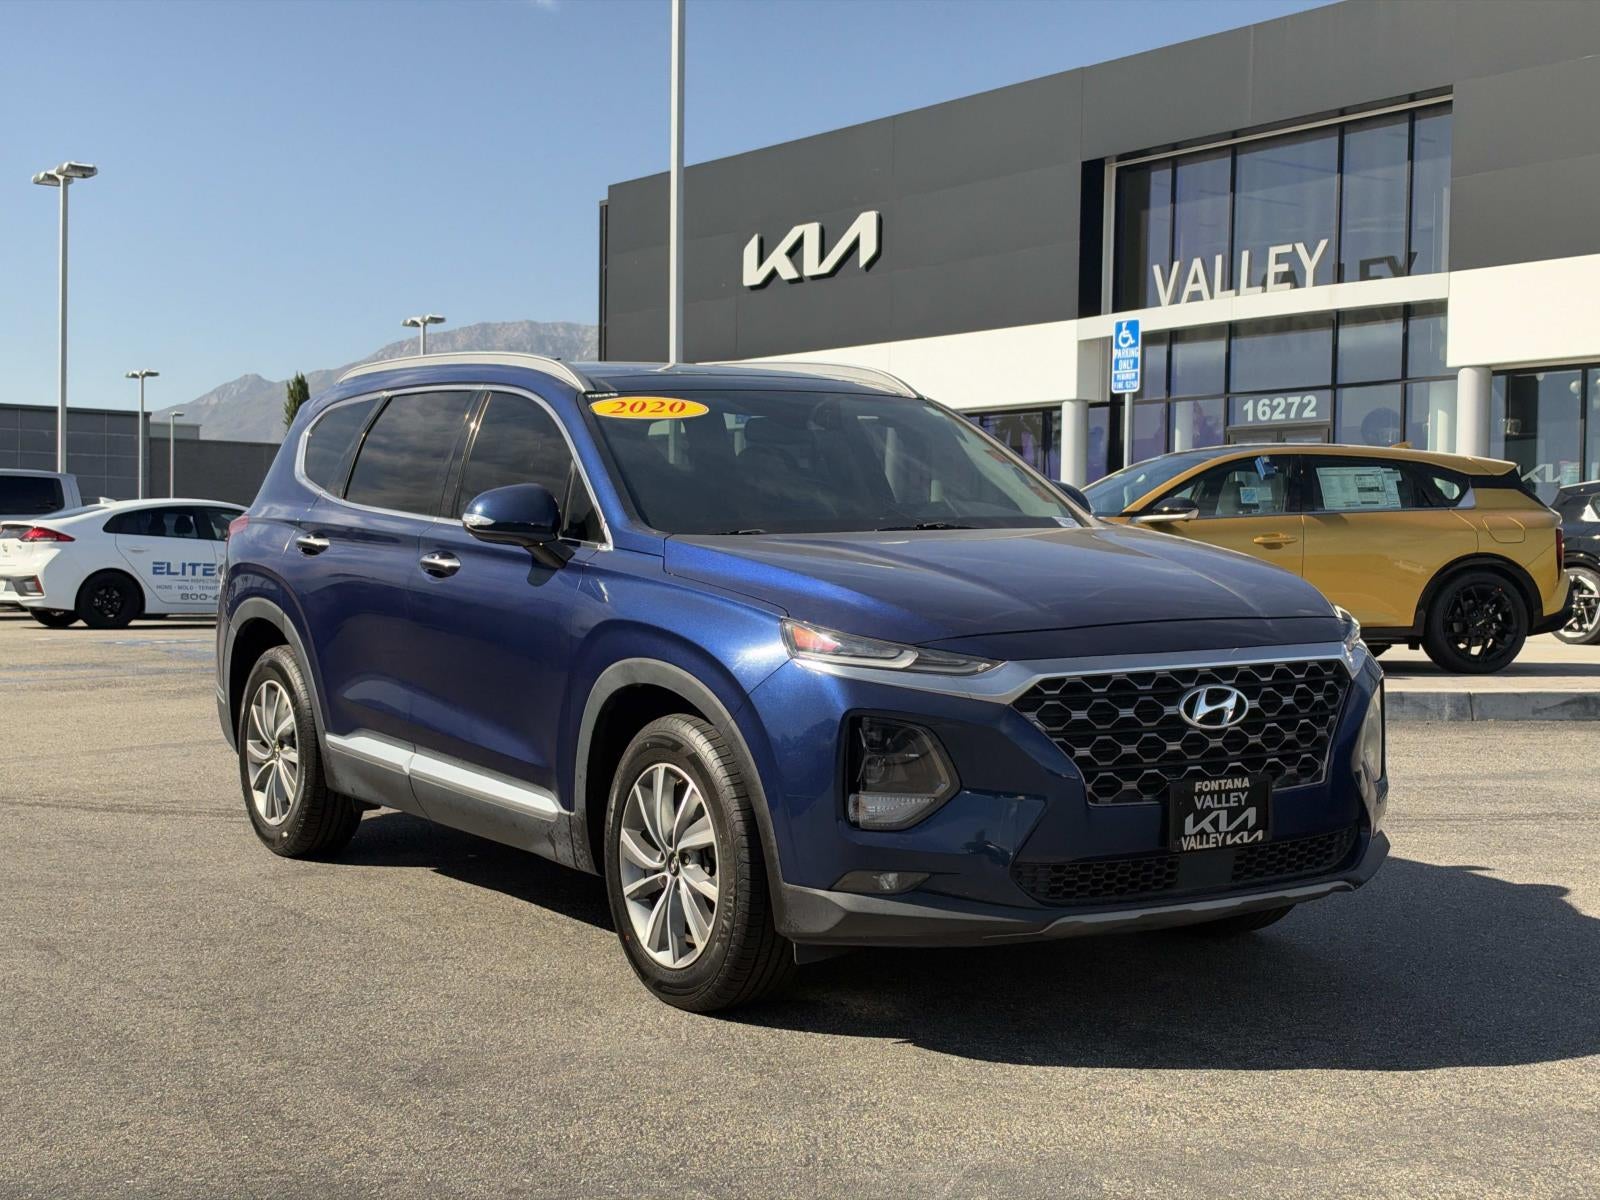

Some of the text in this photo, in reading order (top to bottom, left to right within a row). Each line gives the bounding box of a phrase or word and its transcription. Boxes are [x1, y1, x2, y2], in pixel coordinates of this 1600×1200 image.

[742, 210, 881, 287] KIA
[1152, 238, 1329, 306] VALLEY
[1114, 348, 1138, 359] PARKING
[1118, 359, 1134, 370] ONLY
[610, 401, 686, 414] 2020
[1243, 394, 1318, 422] 16272
[152, 561, 217, 576] ELITE
[1195, 777, 1250, 791] FONTANA
[1194, 791, 1248, 809] VALLEY
[1184, 807, 1257, 835] KIA
[1181, 829, 1263, 851] VALLEY KIA
